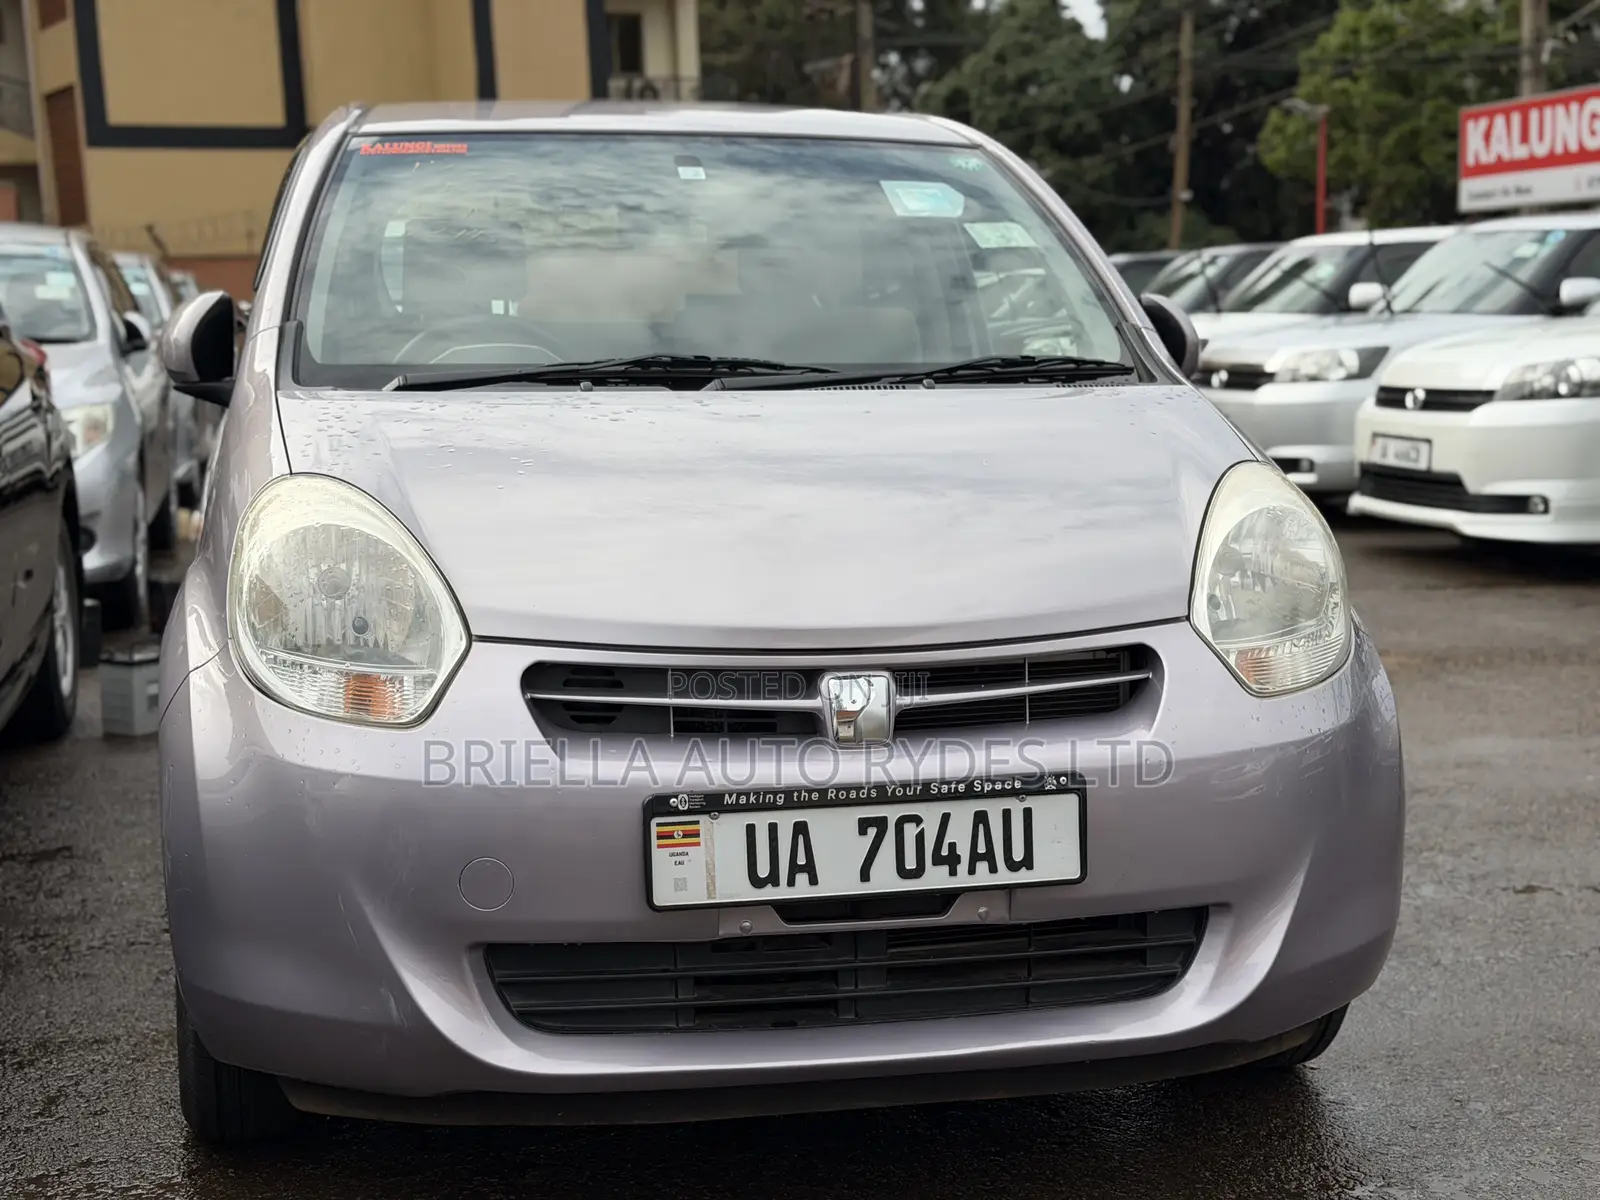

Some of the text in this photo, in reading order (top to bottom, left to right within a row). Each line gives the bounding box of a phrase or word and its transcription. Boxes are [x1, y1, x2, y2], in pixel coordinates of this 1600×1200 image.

[723, 779, 1023, 806] Making the Roads Your Safe Space
[744, 806, 1035, 889] UA 704AU
